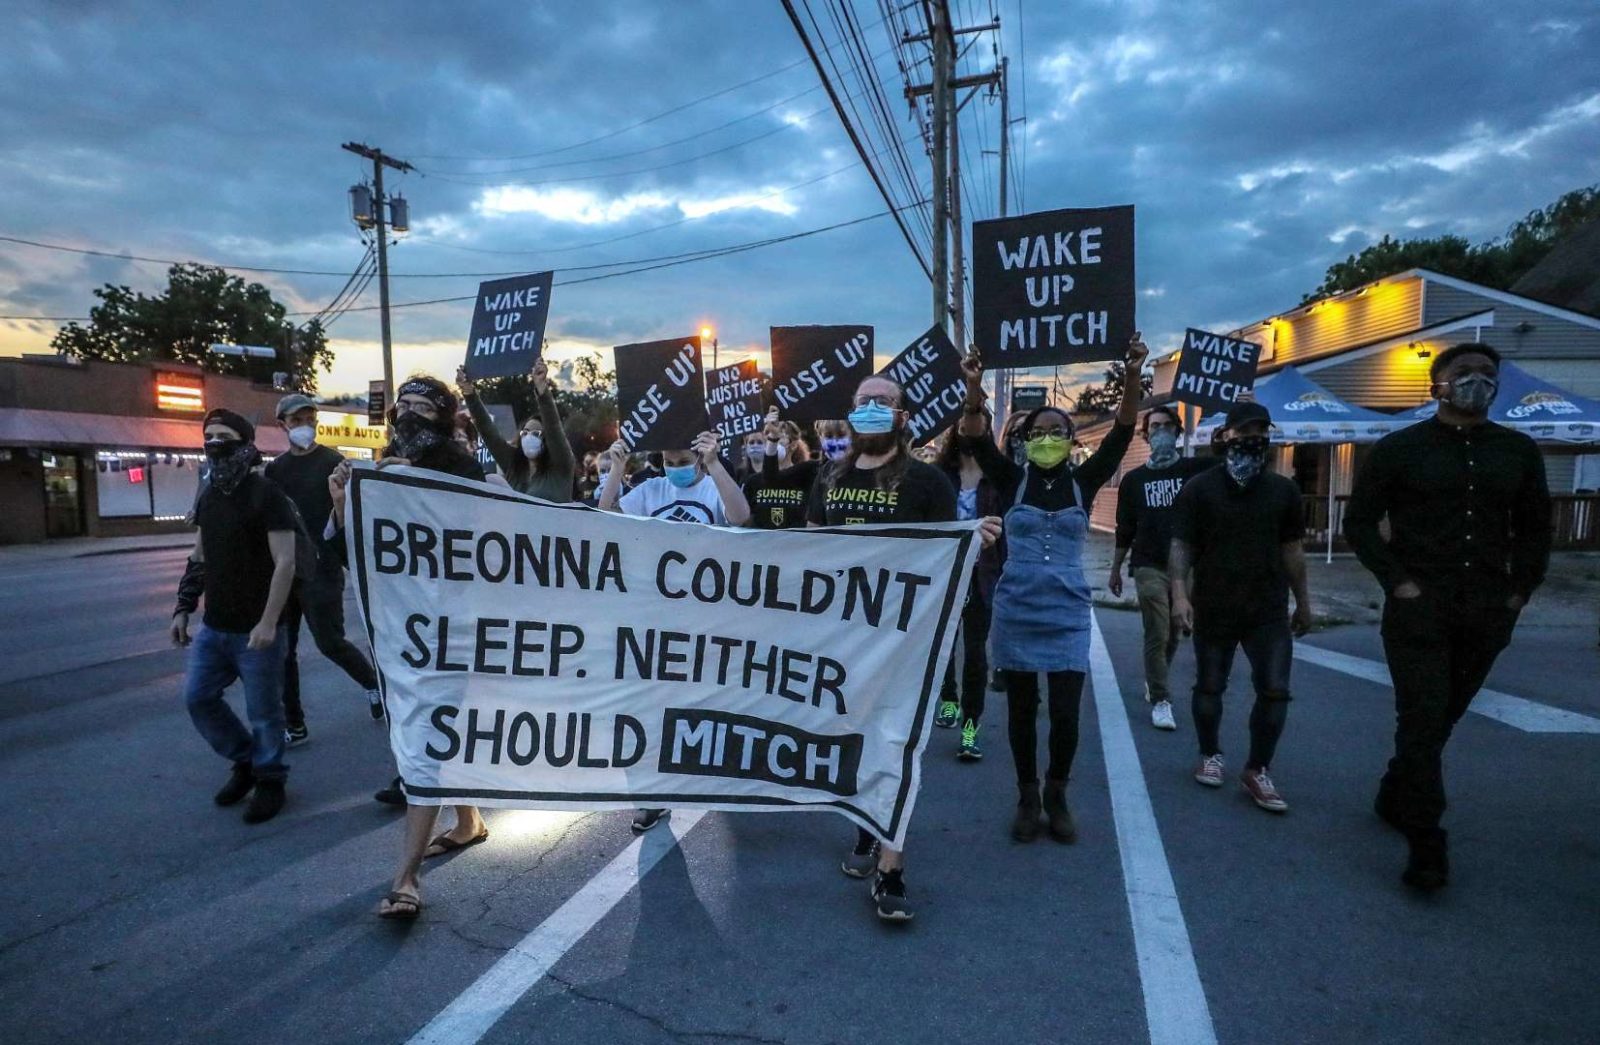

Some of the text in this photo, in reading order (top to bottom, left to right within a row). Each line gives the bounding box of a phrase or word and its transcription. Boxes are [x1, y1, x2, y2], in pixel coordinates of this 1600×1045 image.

[997, 226, 1103, 271] WAKE
[484, 286, 541, 312] WAKE
[1025, 274, 1075, 308] UP
[495, 312, 521, 331] UP
[1000, 310, 1108, 351] MITCH
[473, 331, 535, 356] MITCH
[1189, 332, 1254, 363] WAKE
[719, 366, 740, 384] NO
[774, 333, 869, 409] RISE UP
[1201, 356, 1232, 376] UP
[620, 343, 696, 447] RISE UP
[708, 378, 762, 405] JUSTICE
[905, 372, 934, 404] UP
[723, 401, 746, 419] NO
[907, 378, 968, 439] MITCH
[317, 425, 351, 438] ONN'S
[354, 427, 381, 439] AUTO
[716, 414, 761, 438] SLEEP
[756, 489, 804, 501] SUNRISE
[826, 487, 899, 506] SUNRISE
[373, 518, 932, 632] BREONNA COULD'NT
[400, 613, 848, 715] SLEEP. NEITHER
[425, 704, 841, 784] SHOULD MITCH
